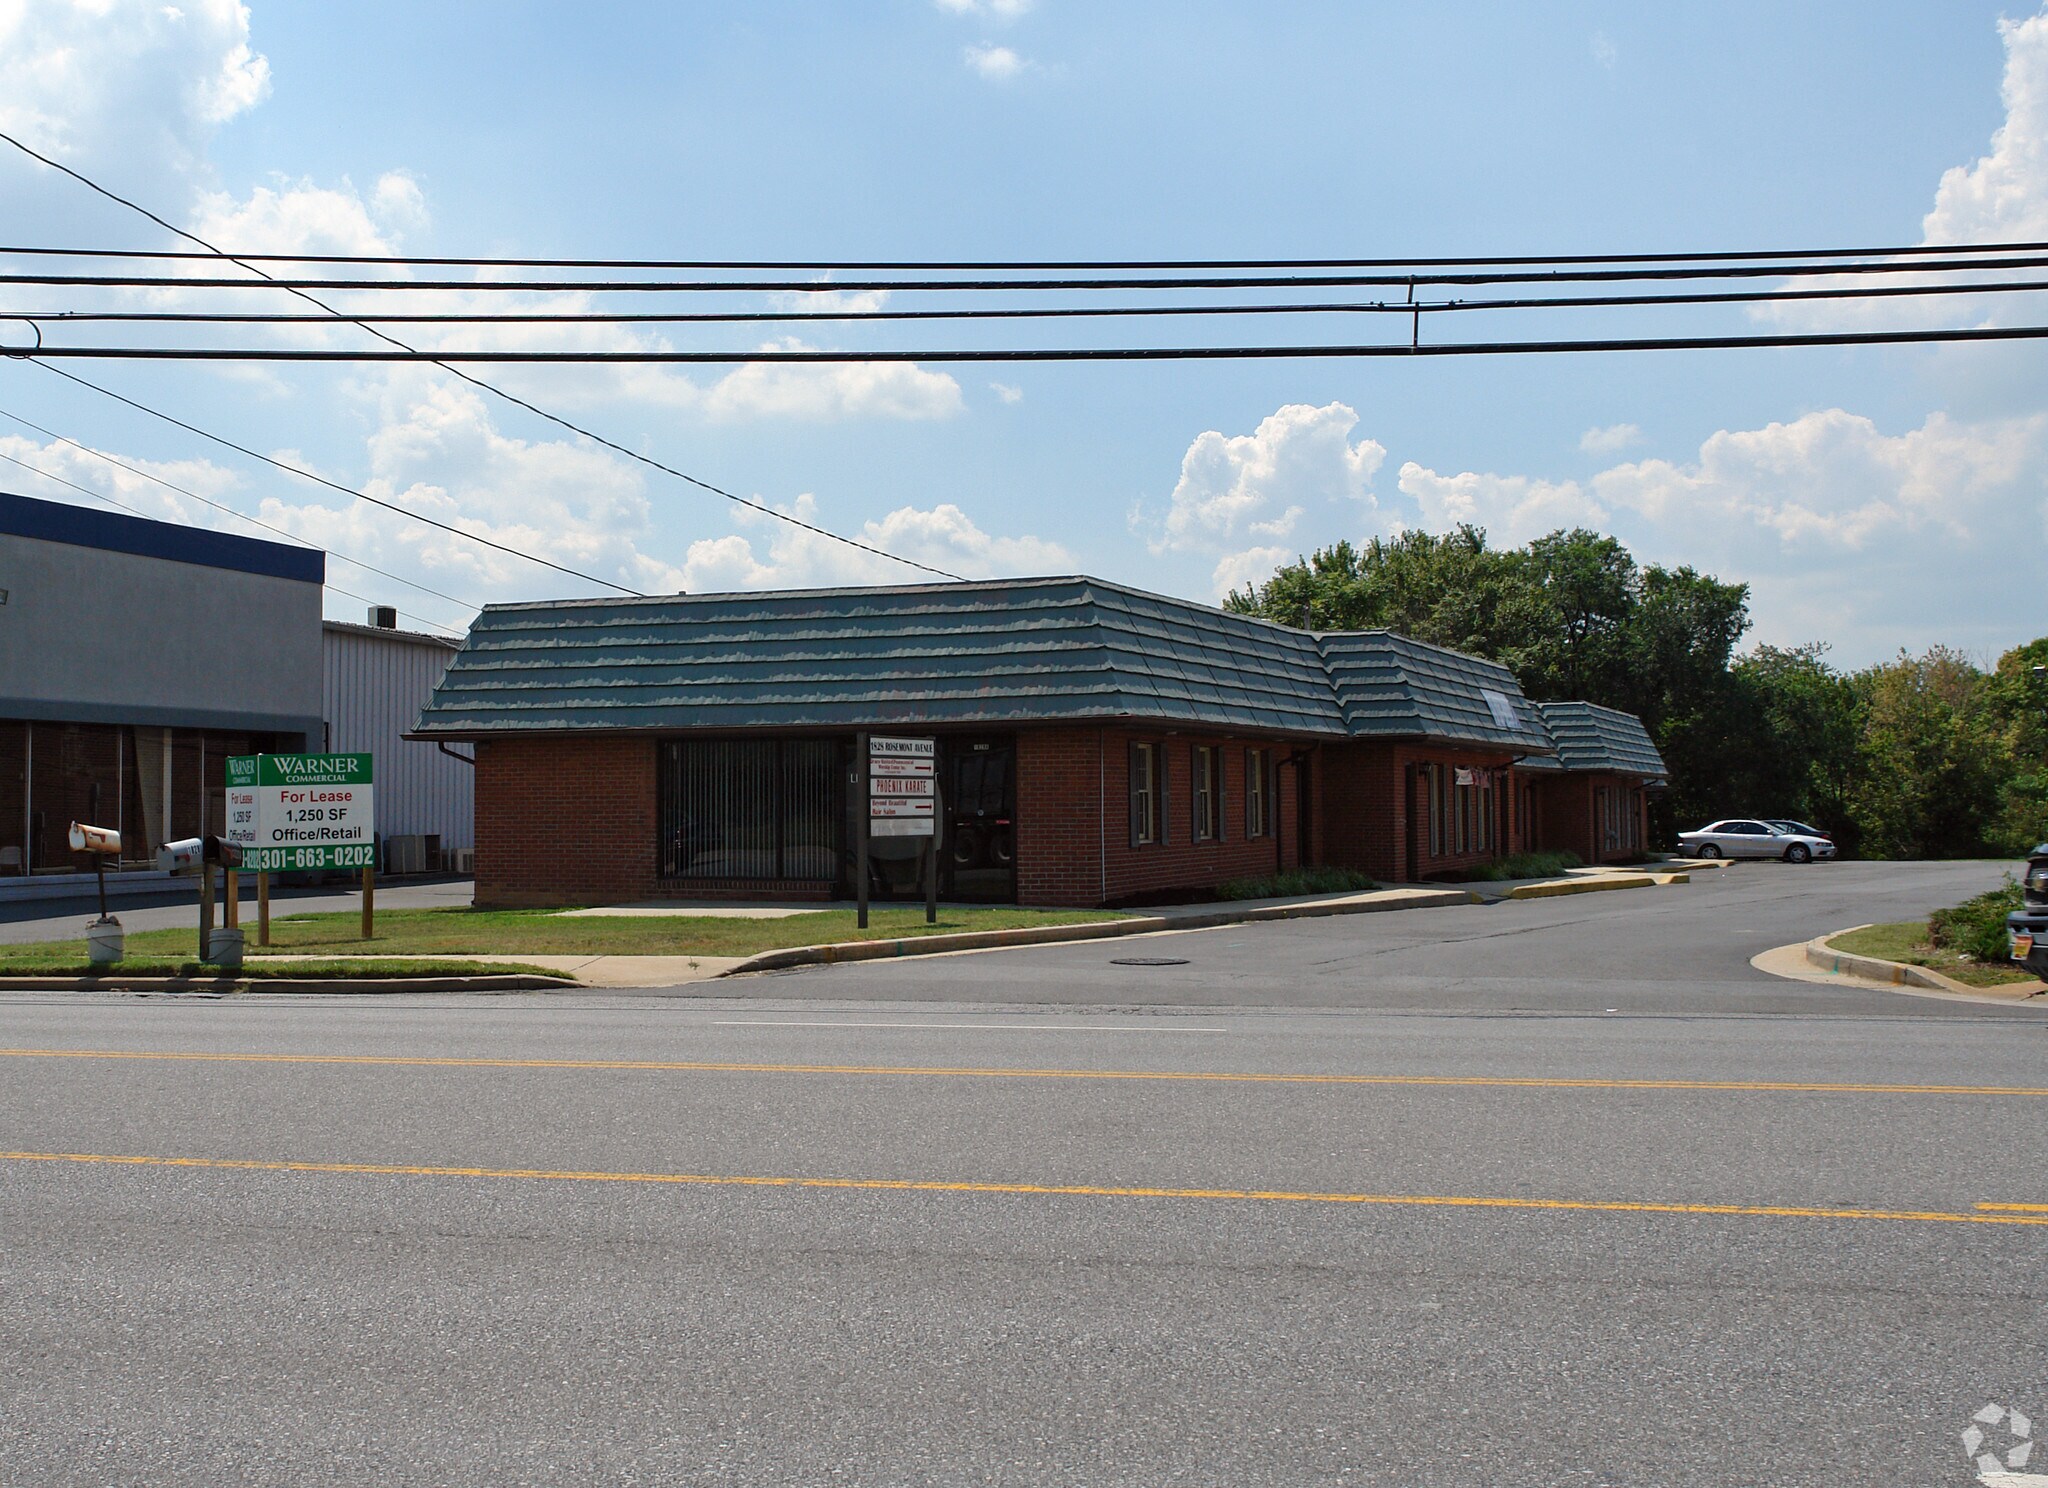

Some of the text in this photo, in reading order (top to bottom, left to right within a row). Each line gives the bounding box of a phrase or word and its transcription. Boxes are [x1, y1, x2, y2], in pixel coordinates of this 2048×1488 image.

[885, 742, 913, 753] ROSEMONT
[915, 743, 933, 753] AVENUE
[229, 760, 255, 775] WARNER
[273, 757, 359, 774] WARNER
[286, 774, 347, 783] COMMERCIAL
[876, 779, 927, 794] PHOENIX KARATE
[231, 793, 253, 804] For Lease
[281, 790, 353, 803] For Lease
[245, 811, 252, 822] SF
[286, 808, 347, 823] 1,250 SF
[272, 827, 362, 841] Office/Retail
[261, 846, 374, 869] 301-663-0202
